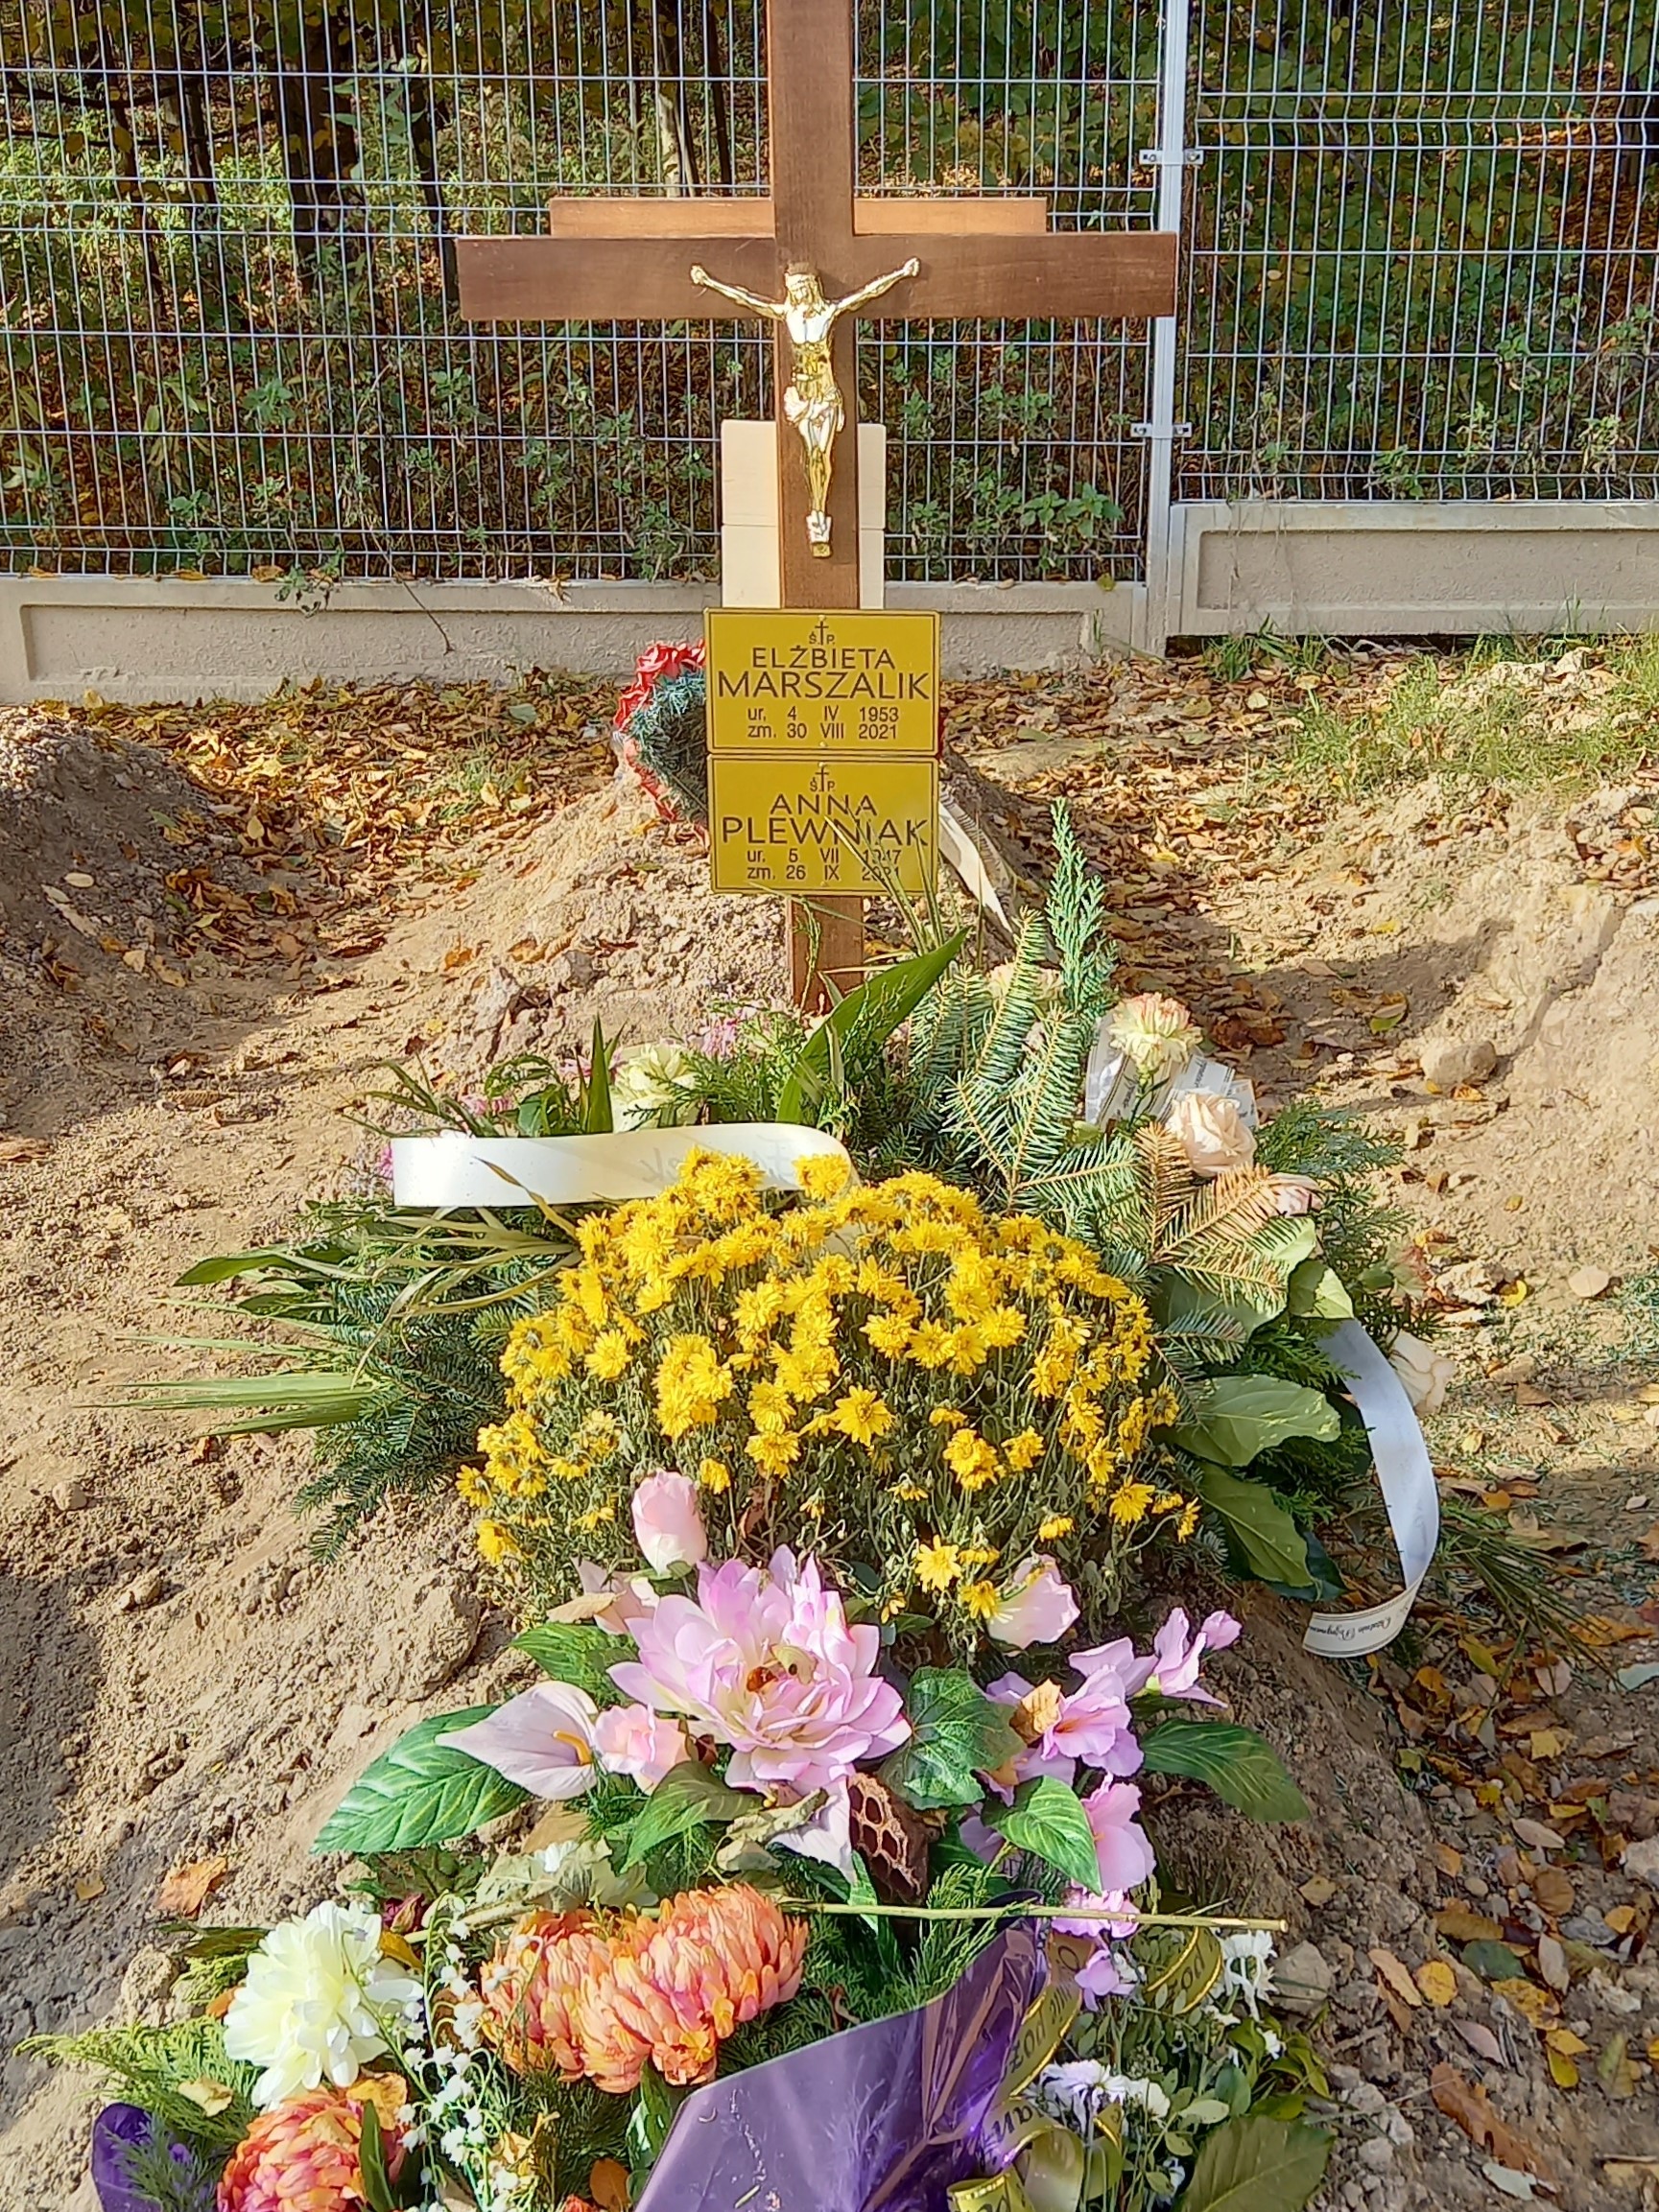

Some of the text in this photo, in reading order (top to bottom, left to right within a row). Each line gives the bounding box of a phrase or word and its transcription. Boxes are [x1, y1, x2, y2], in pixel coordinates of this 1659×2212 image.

[752, 646, 895, 670] ELŻBIETA
[718, 671, 930, 699] MARSZALIK
[747, 705, 899, 721] ur. 4 IV 1953
[747, 723, 897, 740] zm. 30 VIII 2021
[770, 794, 877, 815] ANNA
[723, 817, 928, 846] PLEWNIAK
[747, 849, 766, 862] ur.
[789, 848, 798, 862] 5
[819, 848, 839, 863] VII
[747, 866, 775, 880] zm.
[786, 865, 806, 880] 26
[824, 866, 840, 881] IX
